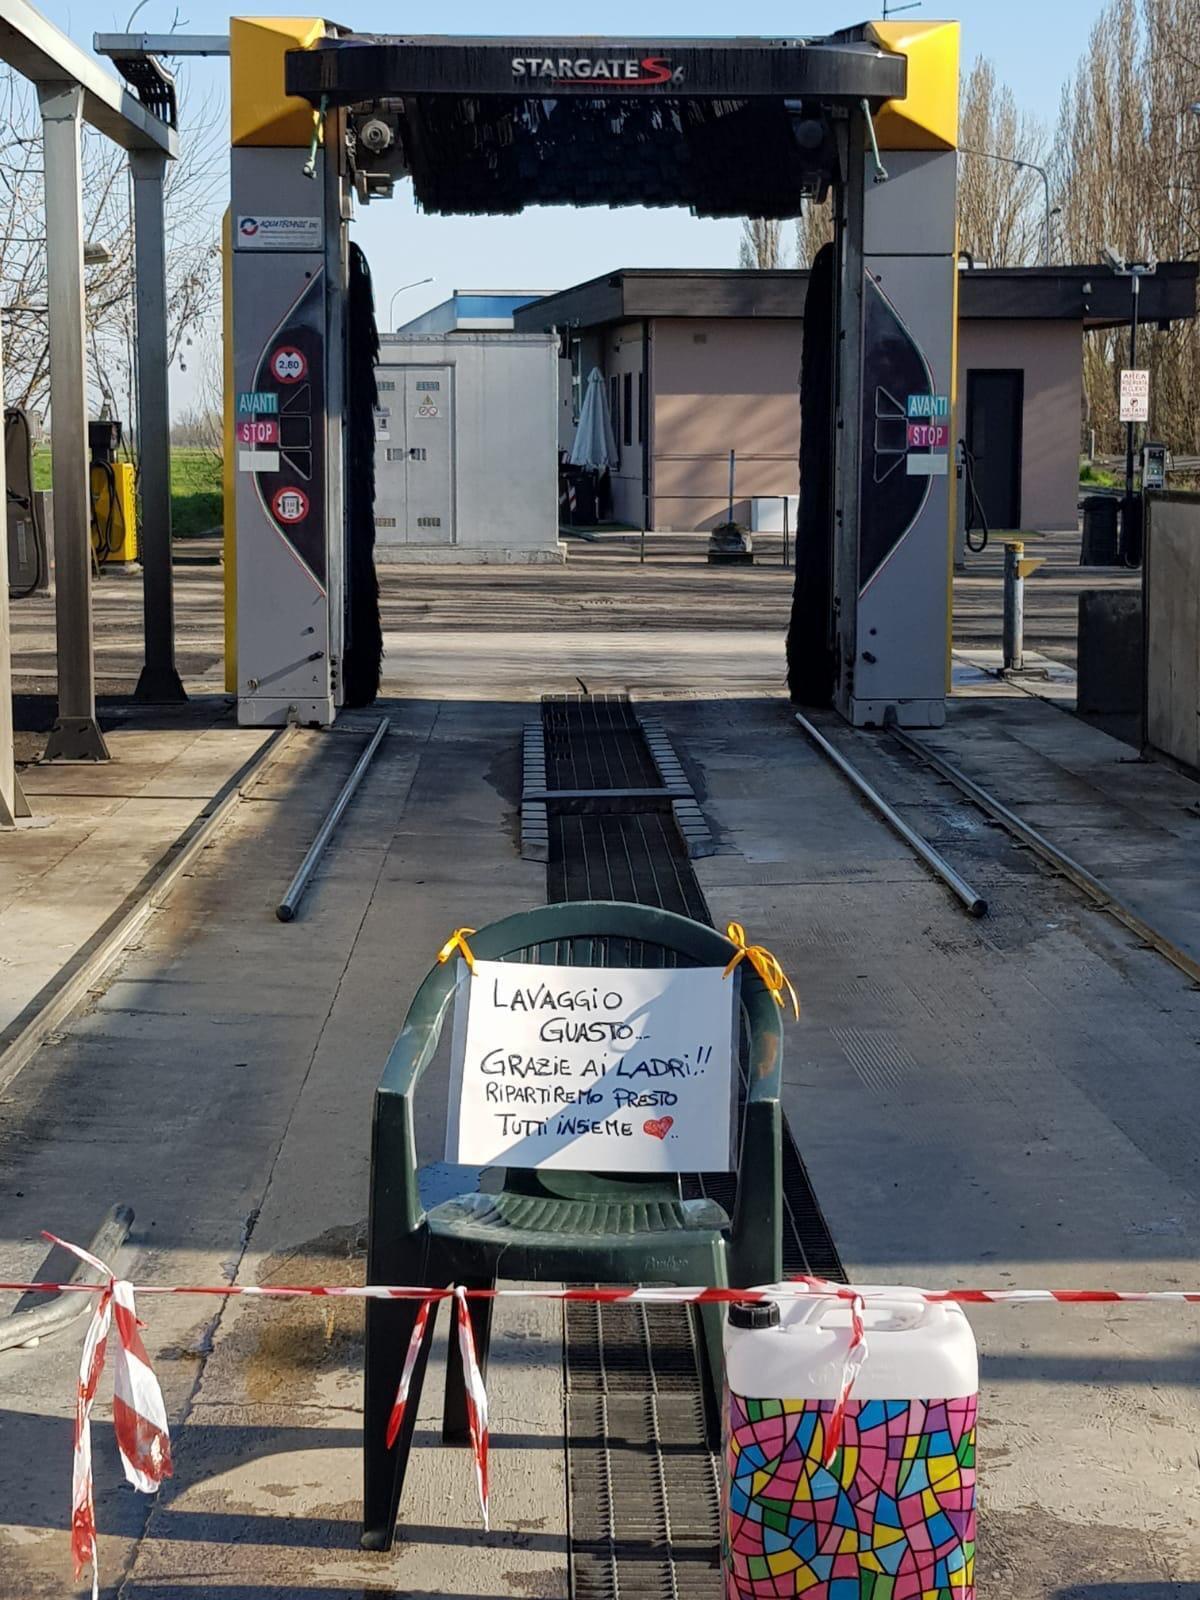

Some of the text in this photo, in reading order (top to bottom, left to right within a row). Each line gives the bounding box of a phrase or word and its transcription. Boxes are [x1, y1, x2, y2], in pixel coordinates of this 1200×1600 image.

[511, 58, 639, 77] STARGATE
[239, 393, 278, 413] AVANTI
[910, 396, 948, 416] AVANTI
[243, 424, 273, 441] STOP
[913, 426, 943, 445] STOP
[493, 977, 623, 1012] LAVAGGIO
[480, 1048, 572, 1077] GRAZIE
[580, 1053, 608, 1077] AI
[486, 1081, 679, 1109] RIPARTIREMO PRESTO
[494, 1112, 634, 1137] TUTTI INSIEME
